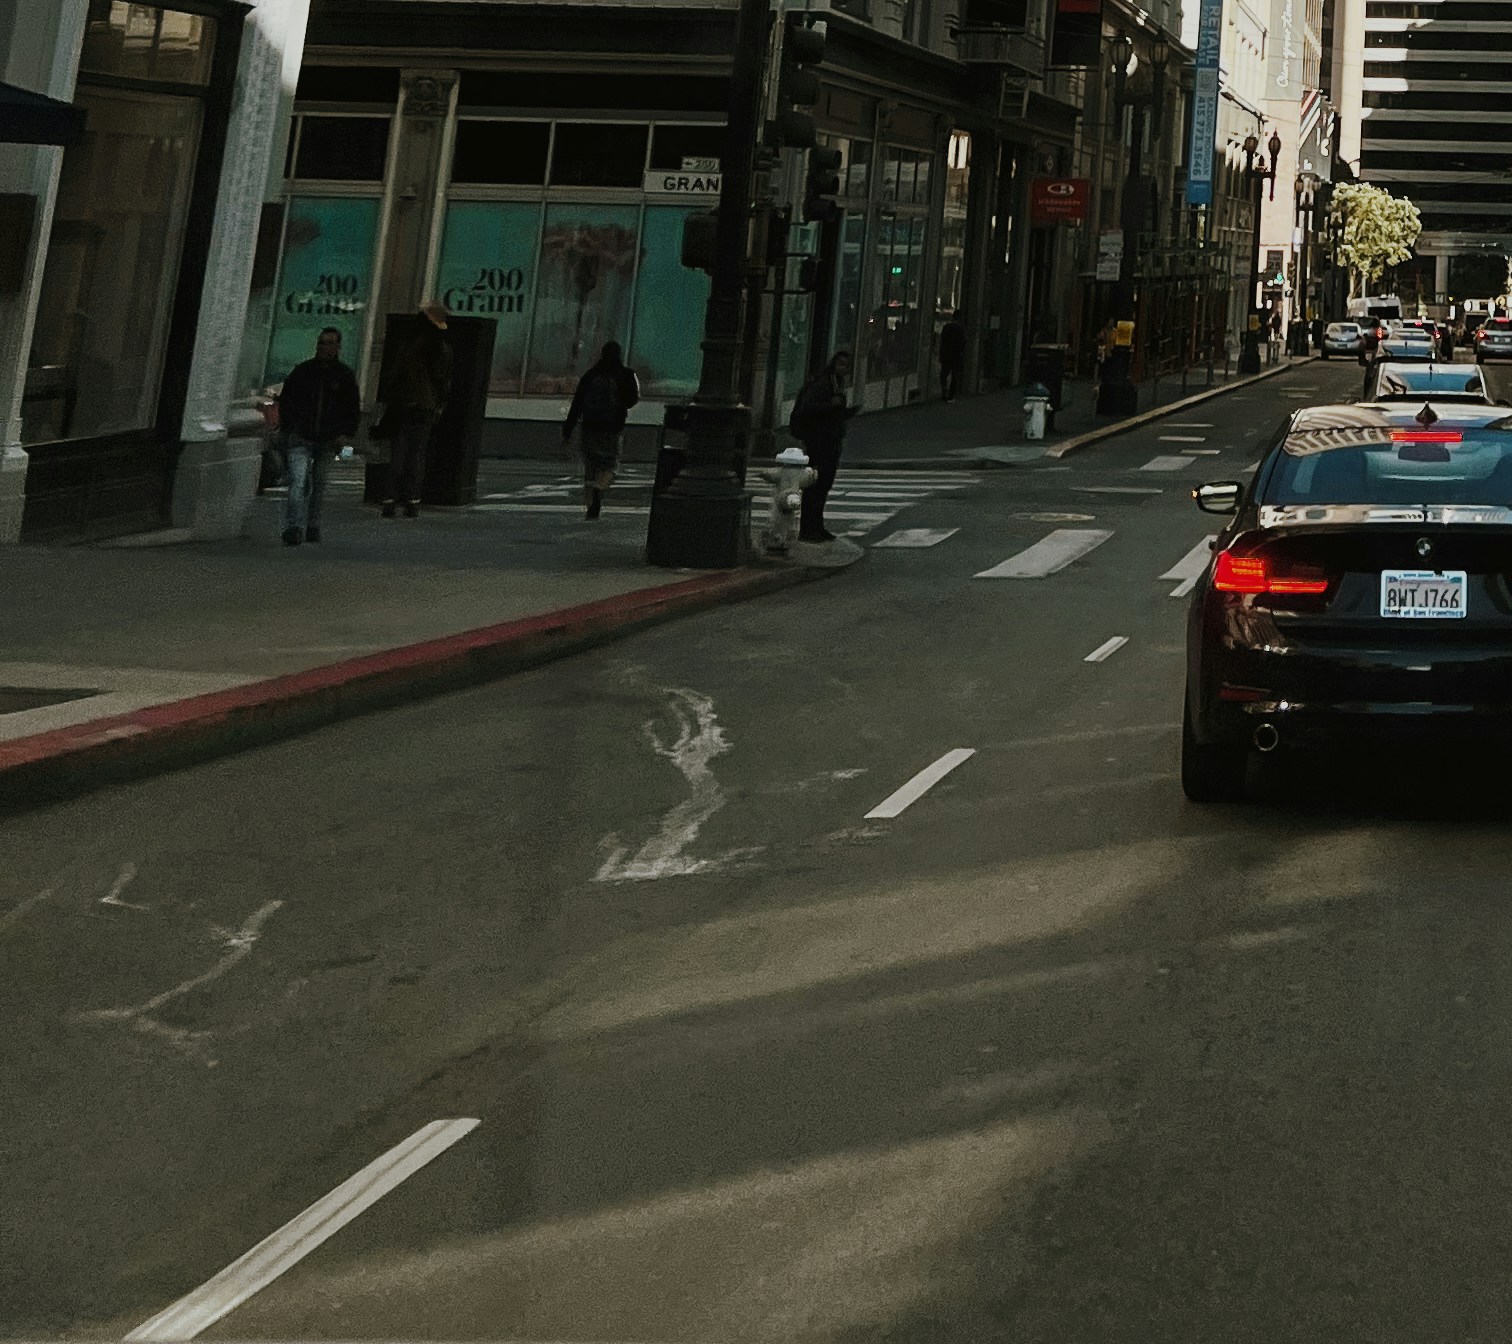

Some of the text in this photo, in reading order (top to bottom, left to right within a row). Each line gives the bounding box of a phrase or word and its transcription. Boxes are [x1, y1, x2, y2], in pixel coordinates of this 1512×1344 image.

[1206, 5, 1220, 65] RETAIL
[663, 176, 720, 192] GRAN
[317, 274, 358, 296] 200
[472, 268, 523, 292] 200
[443, 287, 525, 313] Grant
